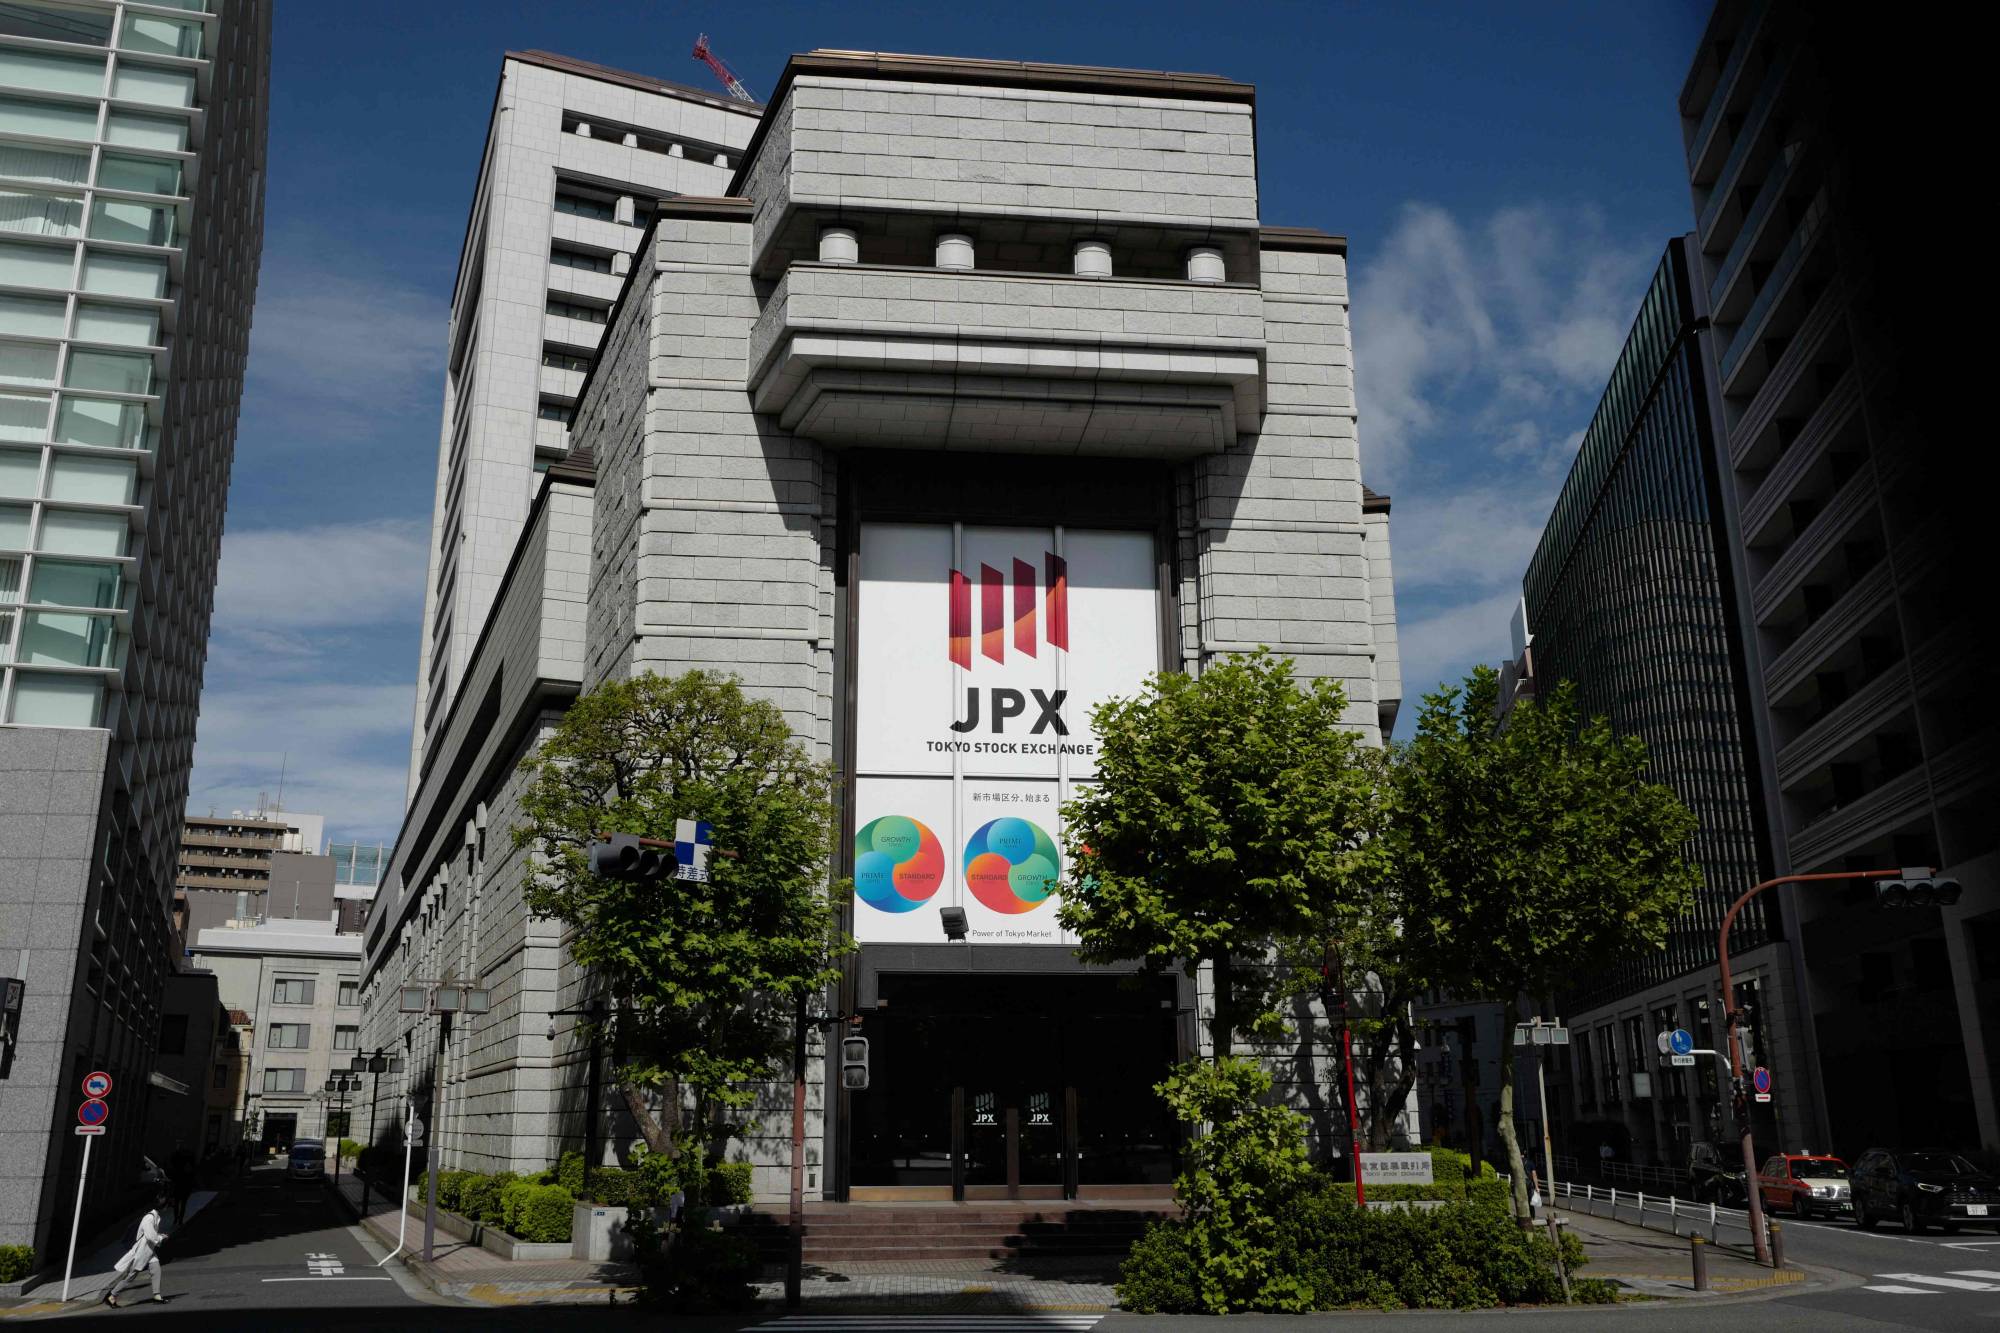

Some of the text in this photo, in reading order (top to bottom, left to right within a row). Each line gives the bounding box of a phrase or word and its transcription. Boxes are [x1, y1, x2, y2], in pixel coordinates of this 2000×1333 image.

[949, 687, 1070, 736] JPX
[927, 741, 1094, 755] TOKYO STOCK EXCHANGE
[973, 792, 1050, 803] 新市場区分、始まる
[1017, 873, 1048, 881] GROWTH
[1005, 930, 1025, 938] Tokyo
[975, 1113, 995, 1123] JPX
[1030, 1113, 1049, 1123] JPX
